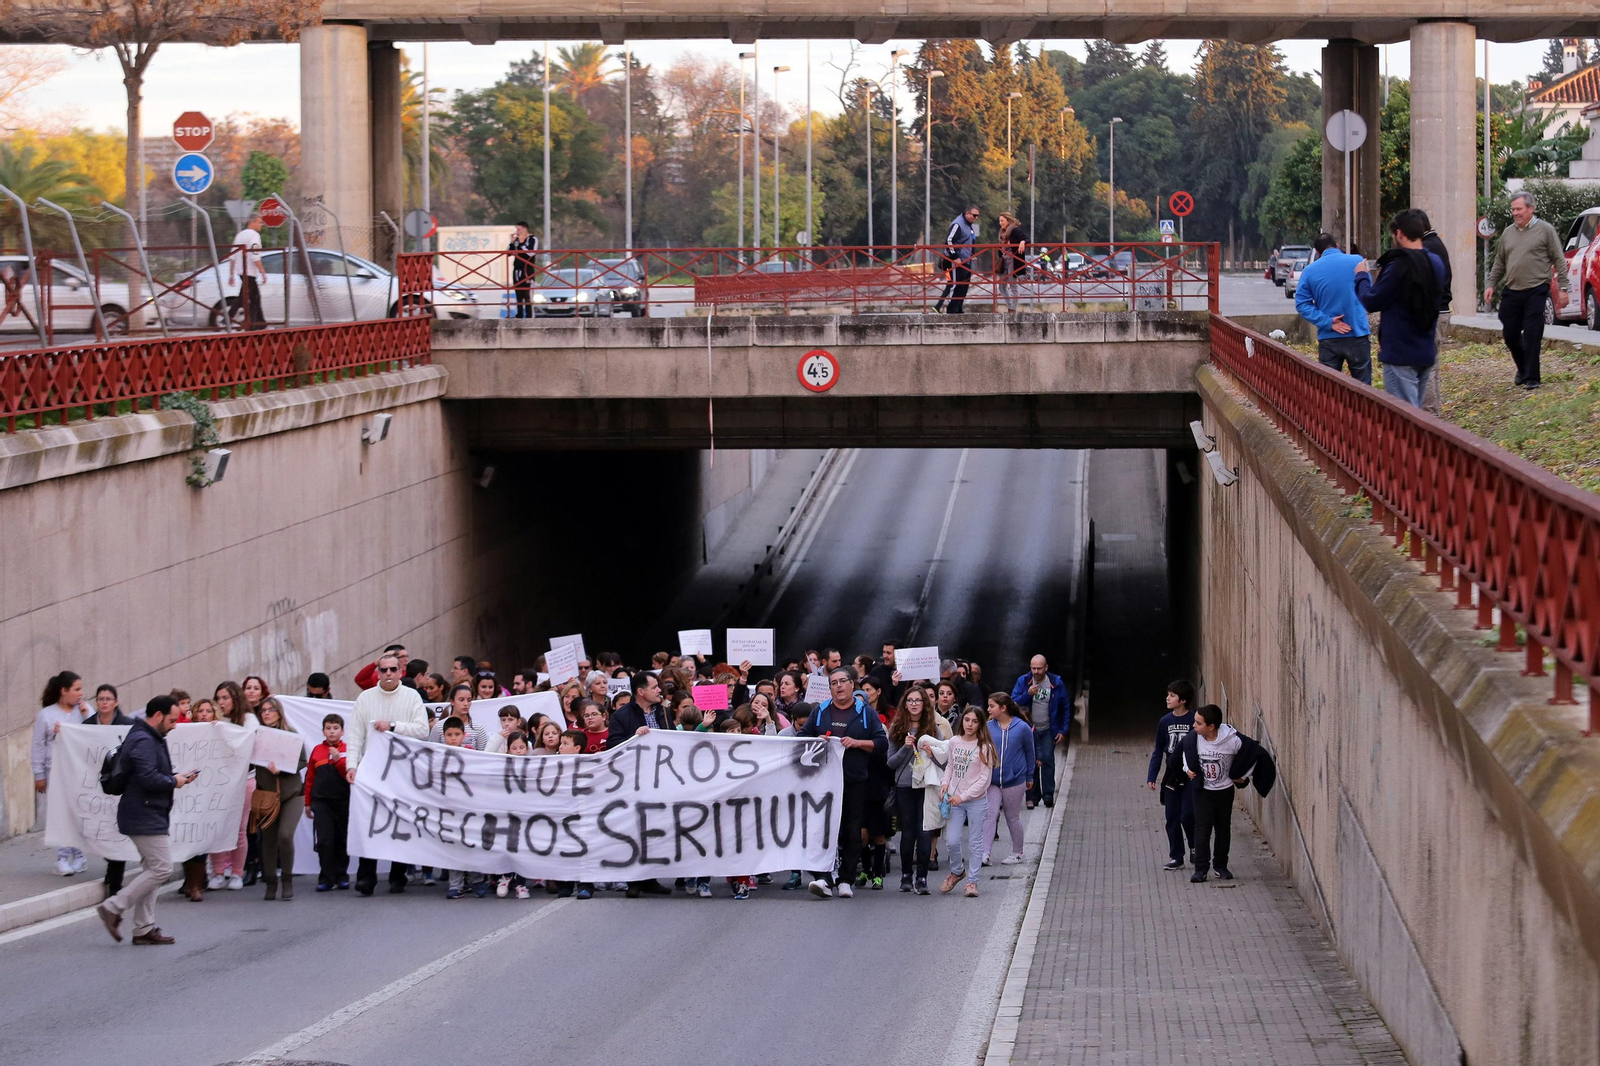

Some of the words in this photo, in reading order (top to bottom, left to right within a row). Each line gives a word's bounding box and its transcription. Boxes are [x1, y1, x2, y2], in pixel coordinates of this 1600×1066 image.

[175, 126, 211, 137] STOP
[381, 736, 473, 797] POR
[503, 740, 760, 797] NUESTROS
[208, 792, 227, 811] EL
[368, 794, 588, 858] DERECHOS
[597, 790, 834, 867] SERITIUM
